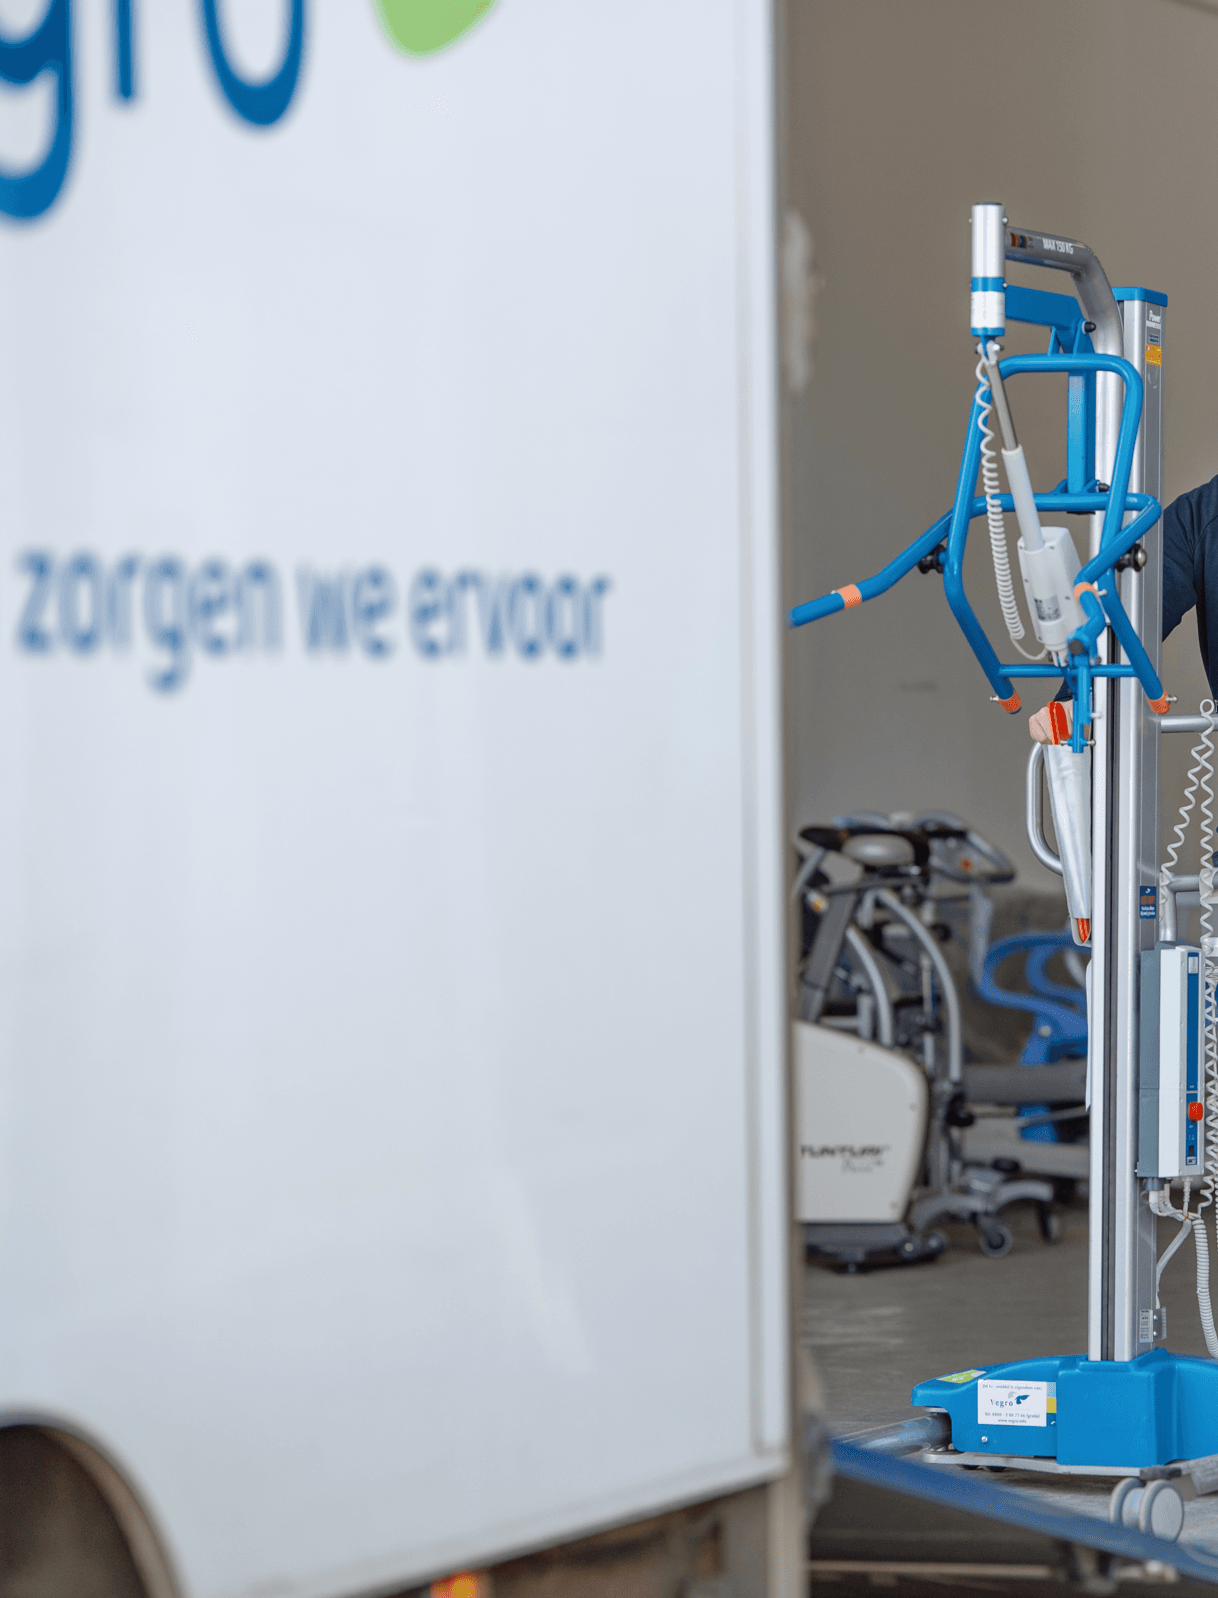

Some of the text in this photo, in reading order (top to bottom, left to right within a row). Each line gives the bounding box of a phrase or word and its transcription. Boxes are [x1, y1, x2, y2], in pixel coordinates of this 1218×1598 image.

[15, 548, 611, 694] zorgen we ervoor
